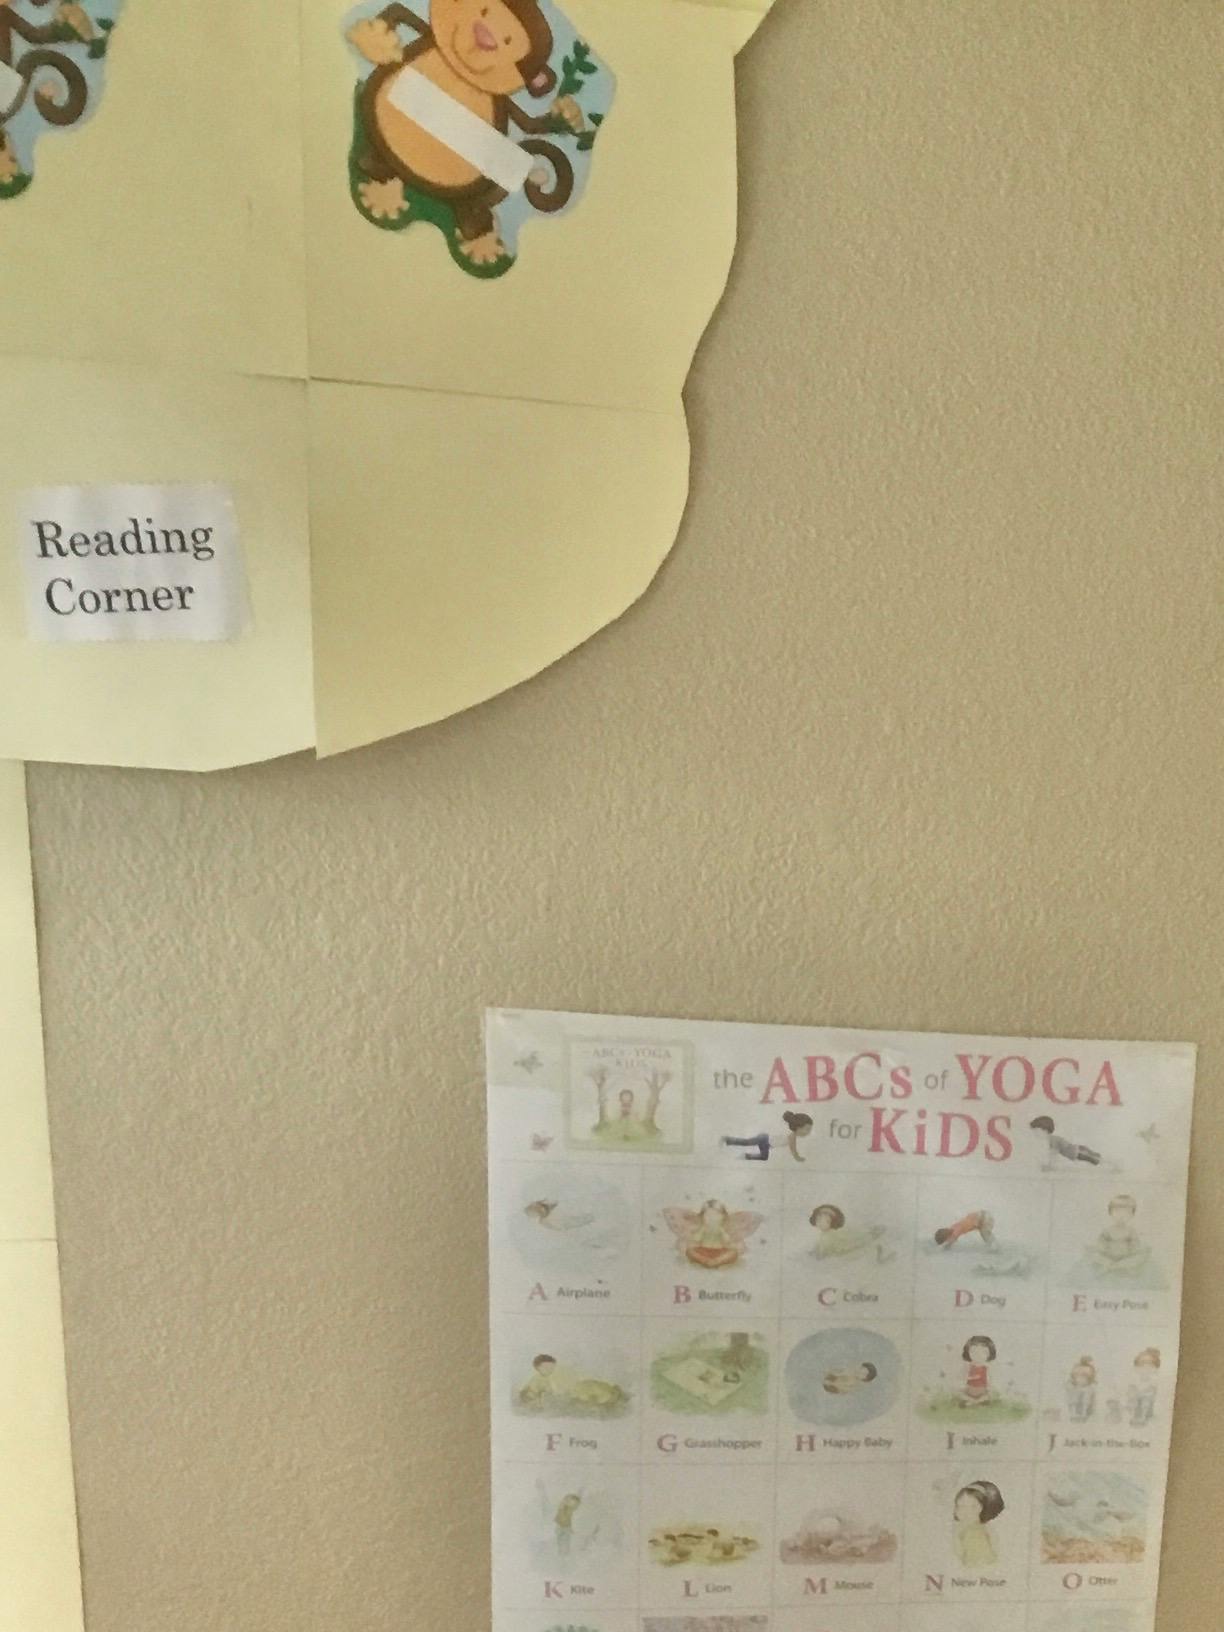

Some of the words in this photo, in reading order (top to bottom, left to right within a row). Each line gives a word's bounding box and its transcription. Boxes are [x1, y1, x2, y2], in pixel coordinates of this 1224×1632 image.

[30, 517, 215, 561] Reading
[45, 577, 195, 615] Corner
[713, 1068, 753, 1090] the
[760, 1052, 913, 1105] ABCs
[924, 1069, 949, 1091] of
[955, 1053, 1123, 1106] YOGA
[829, 1119, 862, 1141] for
[868, 1106, 1013, 1162] KiDS
[528, 1281, 548, 1301] A
[556, 1286, 611, 1300] Airplane
[673, 1285, 692, 1303] B
[698, 1288, 752, 1303] Butterfly
[817, 1287, 837, 1306] C
[843, 1291, 879, 1303] Cobra
[954, 1289, 974, 1307] D
[980, 1294, 1006, 1308] Dog
[1072, 1294, 1087, 1312] E
[545, 1433, 562, 1451] F
[569, 1437, 597, 1450] Frog
[656, 1434, 677, 1452] G
[684, 1438, 762, 1450] Grasshopper
[795, 1434, 815, 1452] H
[823, 1438, 862, 1450] Happy
[865, 1436, 893, 1449] Baby
[946, 1432, 955, 1450] I
[962, 1435, 998, 1446] Inhale
[1047, 1434, 1057, 1452] J
[544, 1580, 563, 1598] K
[570, 1584, 594, 1595] Kite
[683, 1580, 698, 1597] L
[705, 1583, 731, 1594] Lion
[803, 1577, 827, 1595] M
[924, 1574, 944, 1592] N
[1062, 1572, 1082, 1590] O
